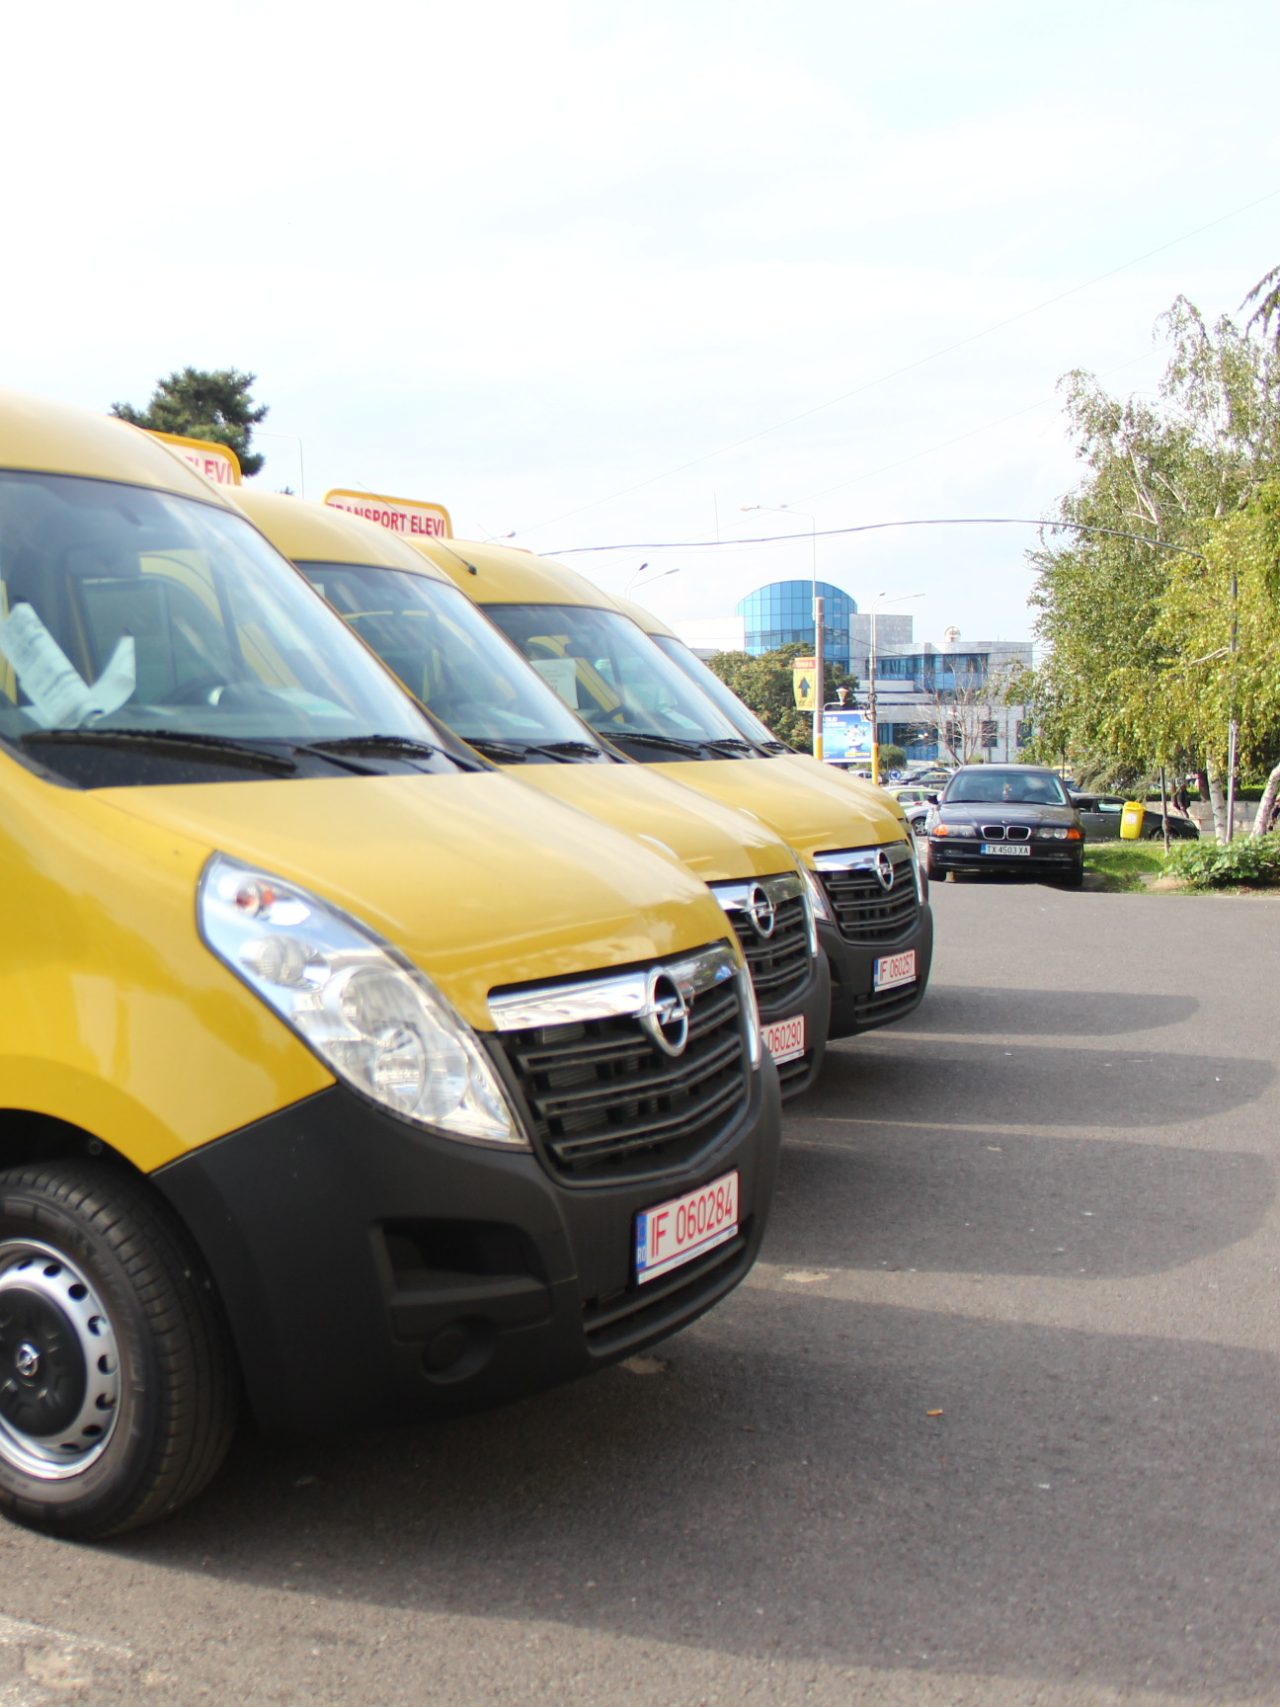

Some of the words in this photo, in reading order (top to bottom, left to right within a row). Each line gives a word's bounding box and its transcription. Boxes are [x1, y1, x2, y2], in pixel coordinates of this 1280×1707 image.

[410, 514, 445, 537] ELEVI
[999, 846, 1017, 855] 4503
[1019, 847, 1029, 855] XA
[768, 1021, 801, 1053] 060290
[651, 1211, 670, 1258] IF
[675, 1180, 733, 1245] 060284
